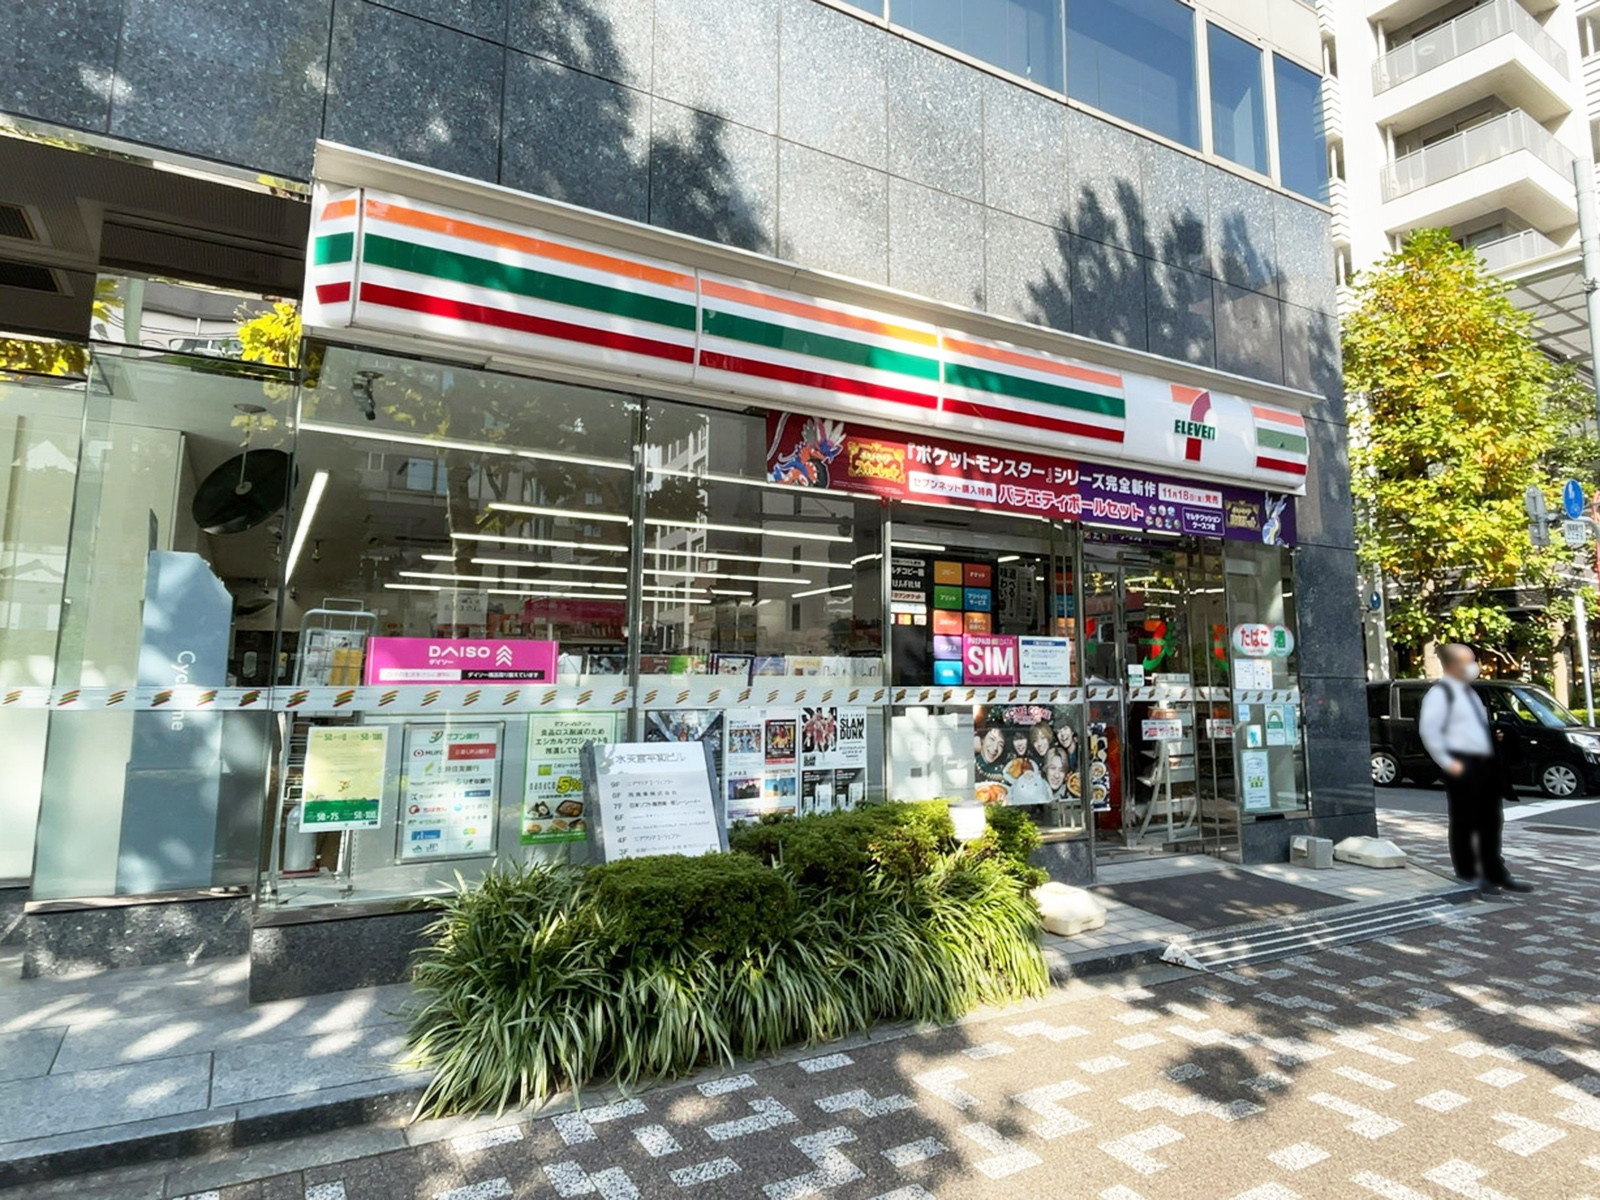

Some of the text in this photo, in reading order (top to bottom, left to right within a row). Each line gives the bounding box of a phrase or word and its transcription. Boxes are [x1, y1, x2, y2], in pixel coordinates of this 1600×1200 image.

[1240, 628, 1269, 648] たばこ
[1274, 630, 1286, 648] 酒
[428, 645, 491, 658] DAISO
[428, 658, 455, 666] ダイソー
[968, 646, 1014, 676] SIM
[840, 718, 865, 729] SLAM
[541, 728, 605, 737] 食品ロス削減のため
[840, 728, 865, 740] DUNK
